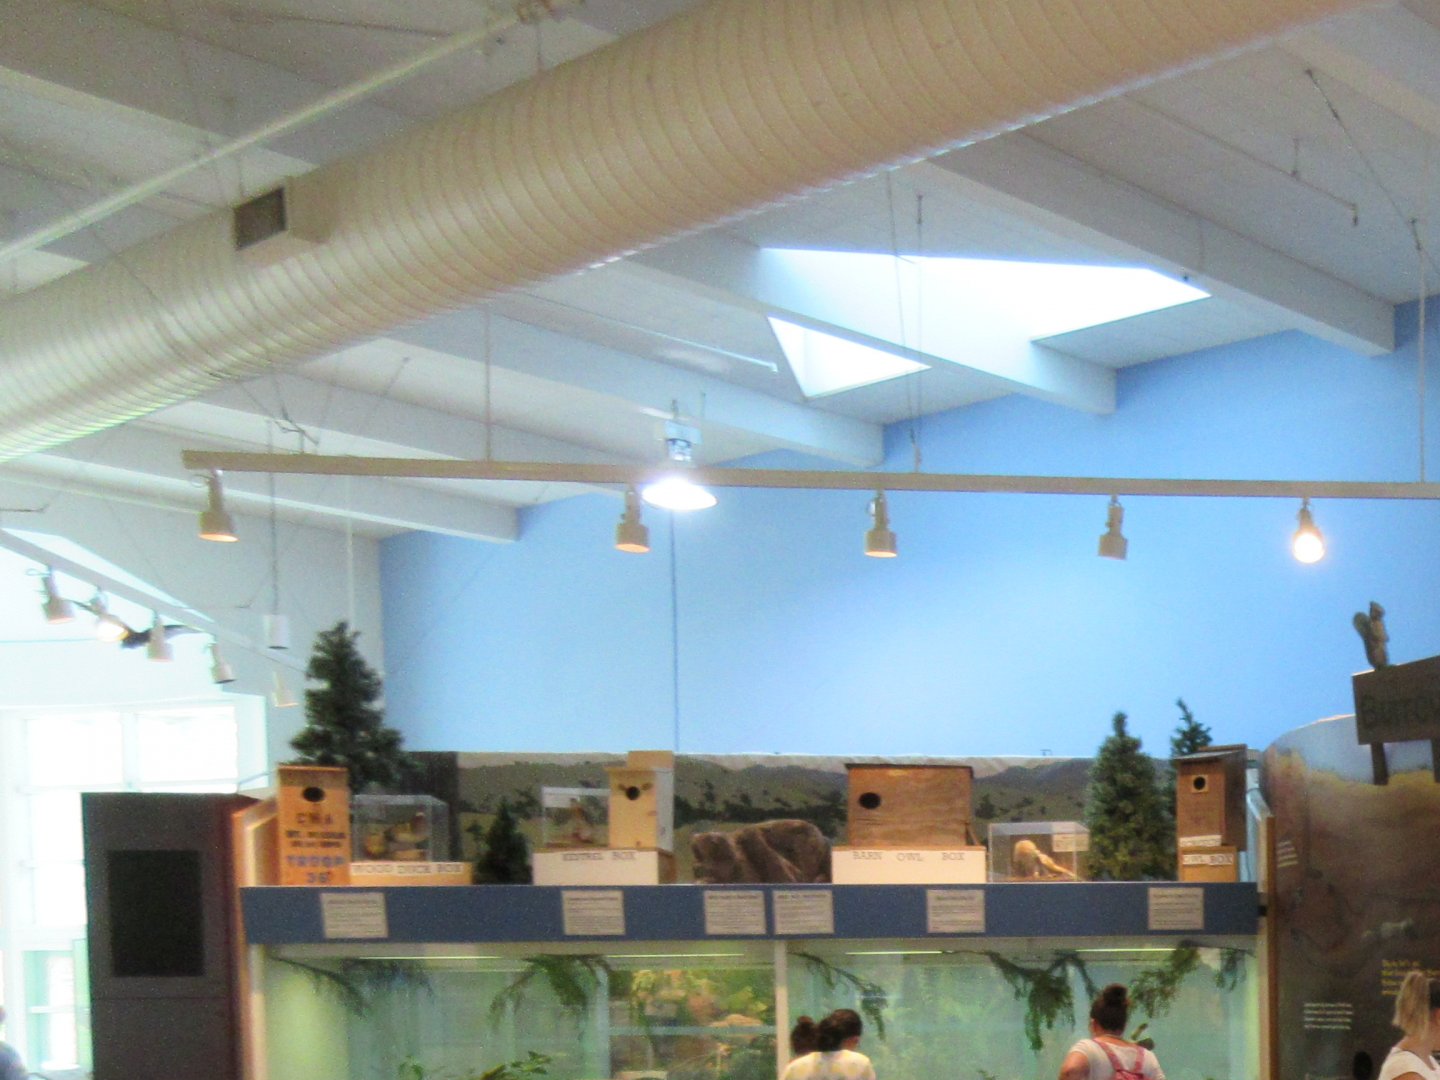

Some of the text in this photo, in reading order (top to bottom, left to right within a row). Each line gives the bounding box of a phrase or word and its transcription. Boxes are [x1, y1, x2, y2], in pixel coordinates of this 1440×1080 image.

[852, 851, 965, 862] BARN OWL BOX
[1209, 853, 1234, 866] BOX
[396, 863, 432, 874] DUCK
[436, 862, 462, 873] BOX
